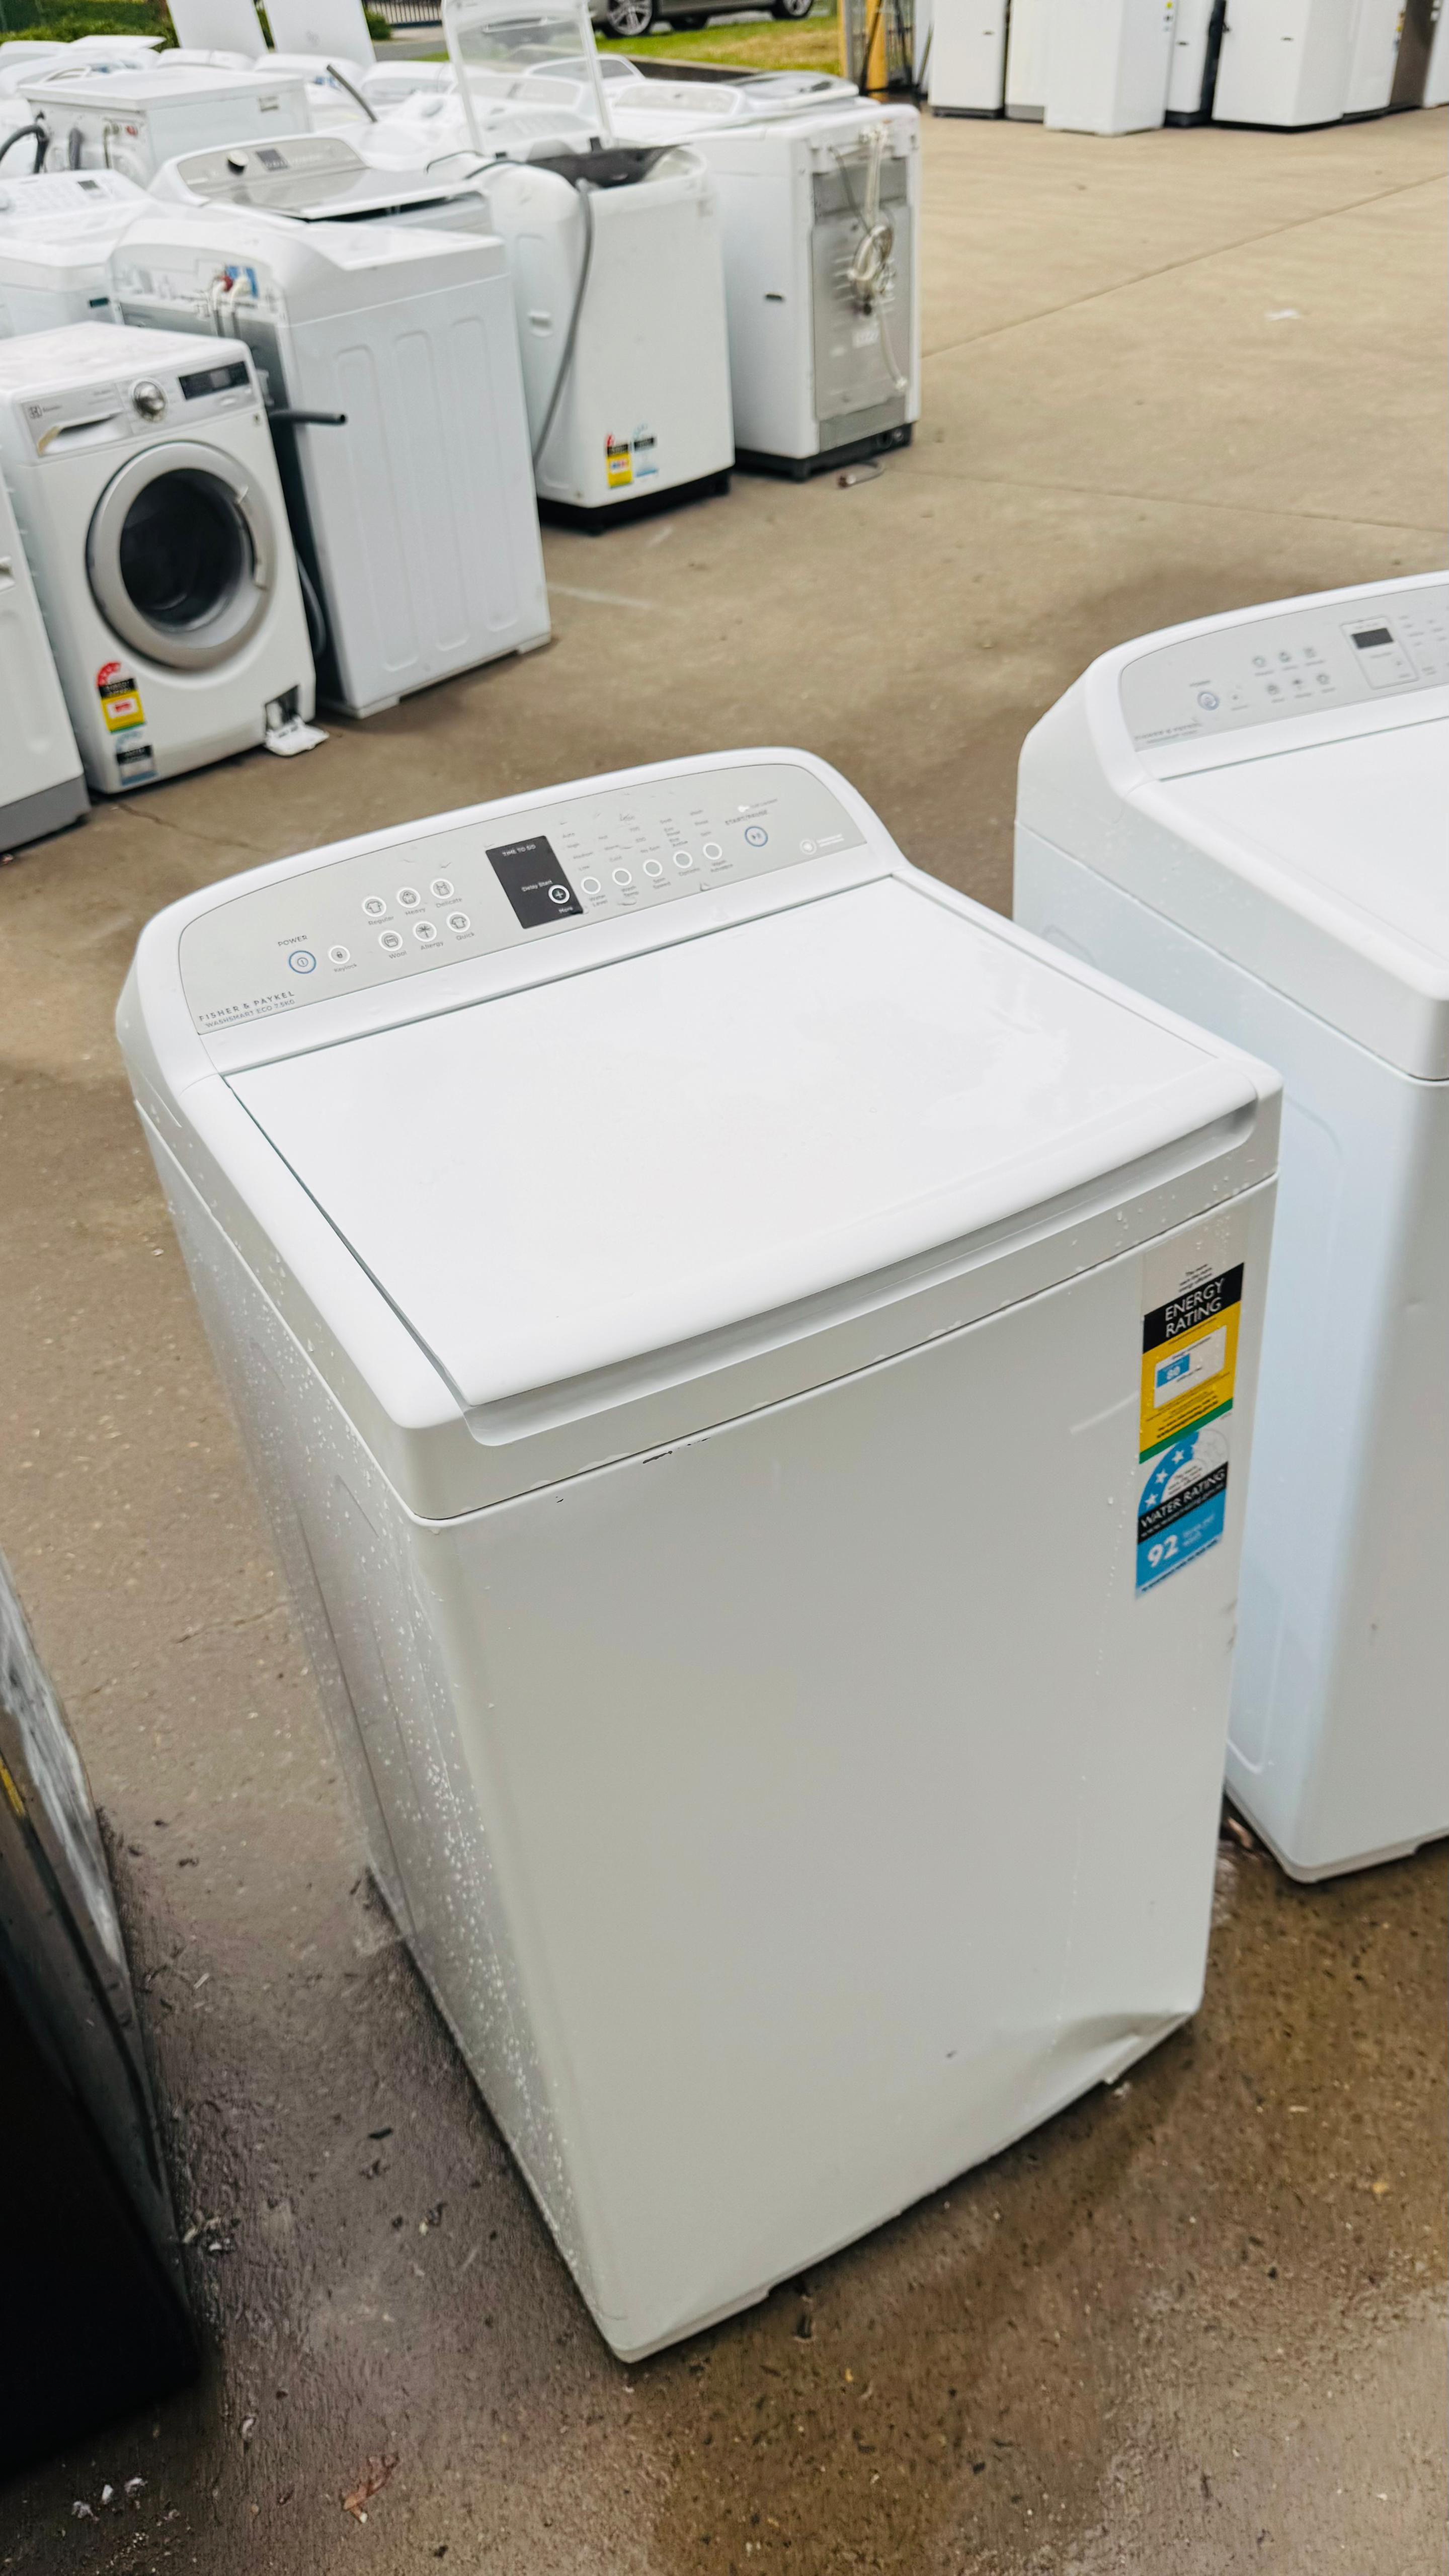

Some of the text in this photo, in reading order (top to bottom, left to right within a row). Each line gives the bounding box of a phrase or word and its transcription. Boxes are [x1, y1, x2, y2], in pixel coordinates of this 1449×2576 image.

[521, 884, 538, 892] Delay
[436, 898, 463, 909] Delicate
[405, 907, 426, 916] Heavy
[368, 916, 394, 926] Regular
[277, 935, 308, 947] POWER
[456, 932, 475, 941] Quick
[421, 941, 444, 950] Allergy
[388, 950, 407, 959] Wool
[334, 963, 358, 973] Keylock
[199, 1005, 240, 1022] FISHER
[253, 990, 295, 1007] PAYKEL
[204, 1010, 255, 1028] WASHSMART
[256, 1005, 273, 1014] ECO
[1165, 1277, 1226, 1322] ENERGY
[1166, 1296, 1222, 1338] RATING
[1140, 1497, 1182, 1528] WATER
[1183, 1468, 1226, 1504] RATING
[1147, 1534, 1180, 1568] 92
